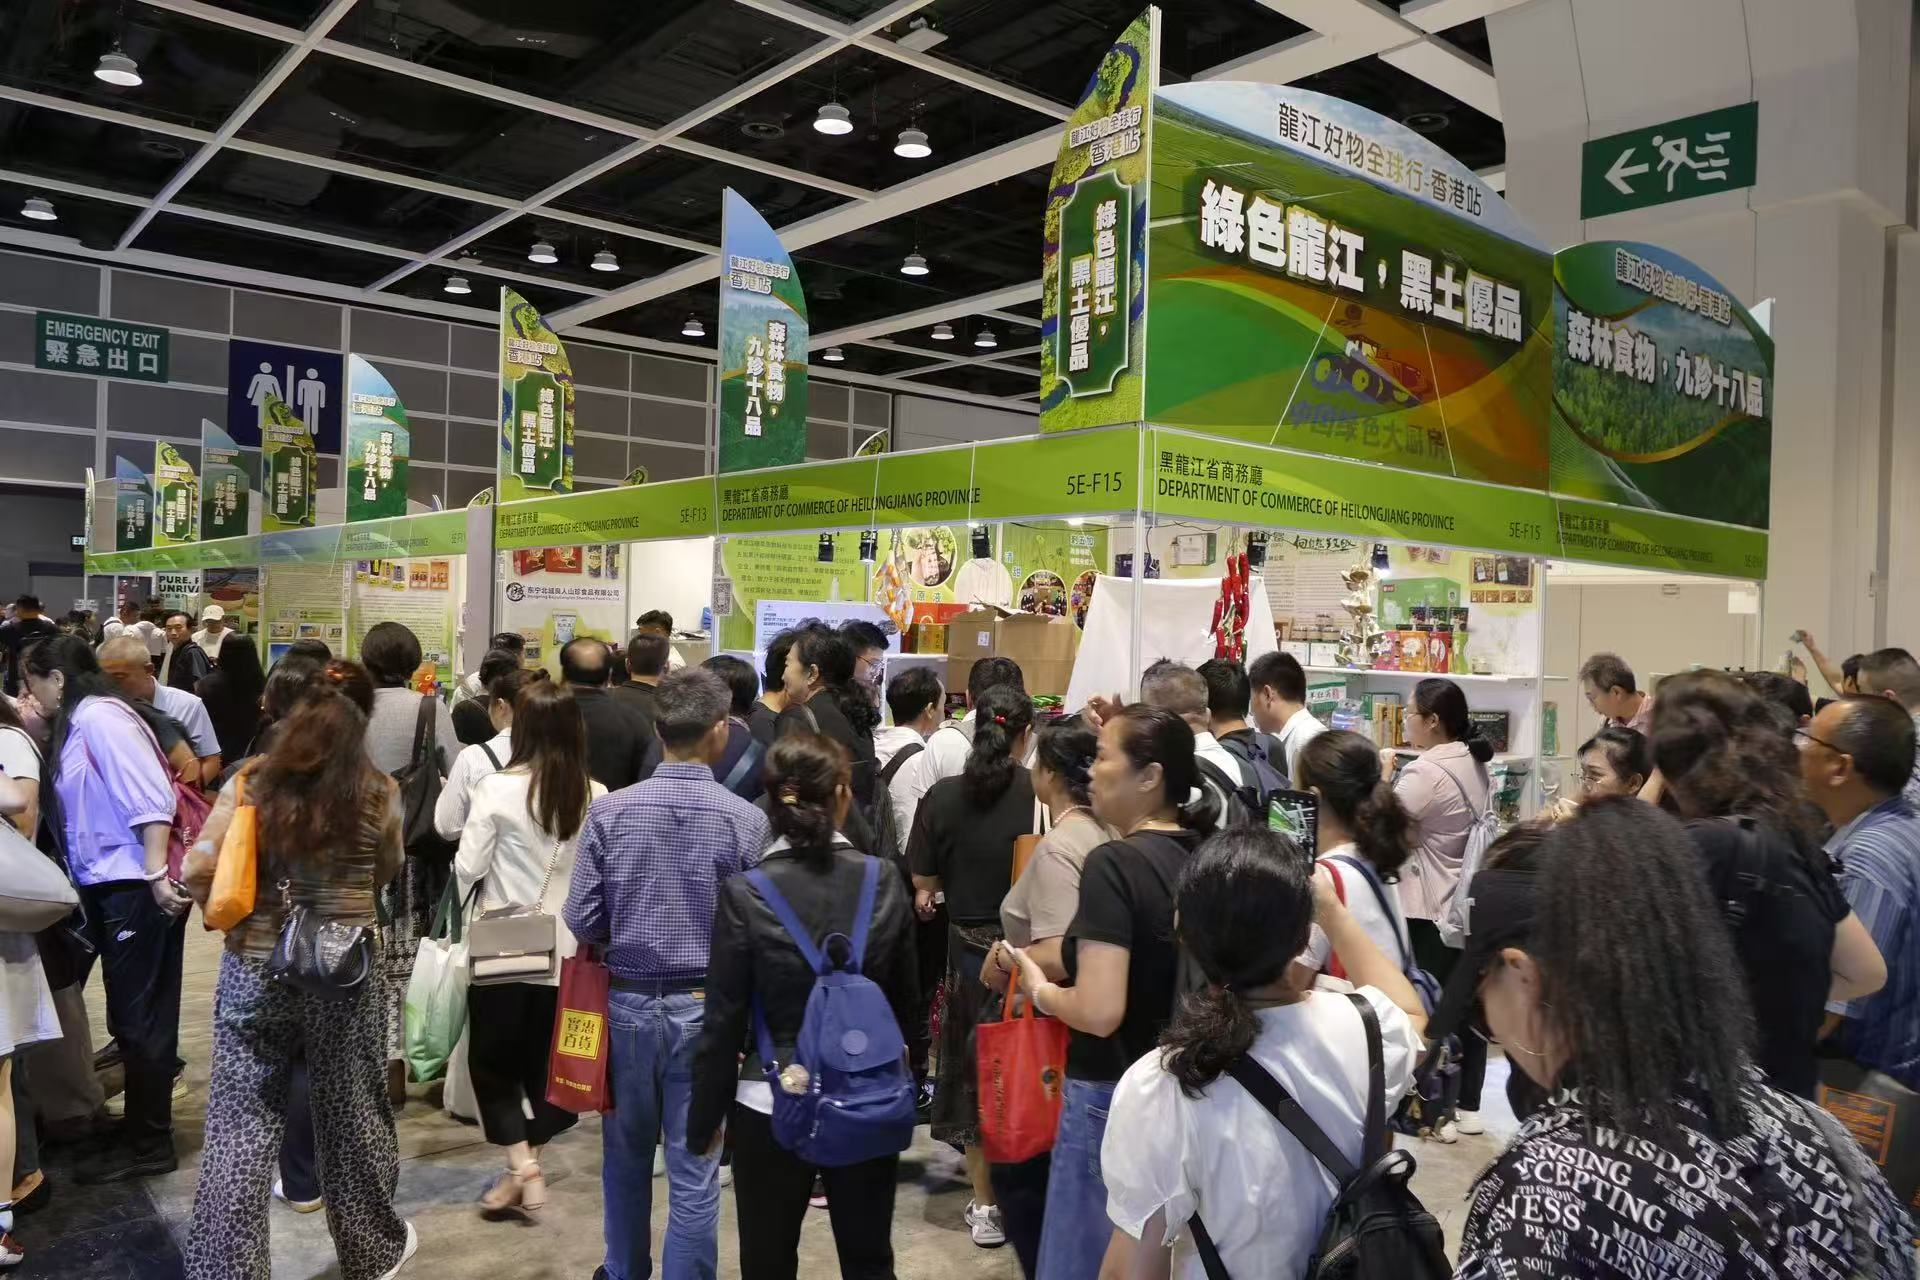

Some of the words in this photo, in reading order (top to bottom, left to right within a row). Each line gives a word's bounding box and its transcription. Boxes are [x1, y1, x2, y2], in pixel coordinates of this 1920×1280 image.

[1069, 106, 1142, 149] 龍江好物全球行
[1090, 131, 1141, 167] 香港站
[1279, 102, 1482, 217] 龍江好物全球行-香港站
[1200, 179, 1522, 342] 綠色龍江，黑土優品
[730, 271, 772, 294] 香港站
[1069, 259, 1091, 372] 黑土優品
[46, 320, 129, 345] EMERGENCY
[132, 332, 160, 350] EXIT
[45, 339, 159, 374] 緊急出口
[1567, 310, 1763, 418] 森林食物，九珍十八品
[745, 336, 764, 437] 九珍十八品
[1160, 451, 1263, 486] 黑龍江省商務廳
[722, 504, 773, 521] DEPARTMENT
[774, 504, 786, 518] OF
[786, 499, 835, 517] COMMERCE
[837, 498, 849, 513] OF
[851, 492, 923, 513] HEILONGJIANG
[926, 487, 980, 506] PROVINCE
[1066, 471, 1122, 496] 5E-F15
[723, 484, 789, 505] 黑龍江省商務廳
[1158, 478, 1240, 505] DEPARTMENT
[1242, 489, 1258, 506] OF
[1260, 491, 1322, 514] COMMERCE
[1324, 500, 1338, 516] OF
[1341, 502, 1409, 525] HEILONGJIANG
[1412, 511, 1455, 531] PROVINCE
[1509, 522, 1541, 540] 5E-F15
[72, 536, 87, 546] EXI
[499, 526, 529, 539] DEPARTMENT
[530, 526, 536, 537] OF
[537, 523, 564, 536] COMMERCE
[564, 522, 571, 534] OF
[611, 516, 639, 530] PROVINCE
[680, 507, 707, 523] 5E-F13
[159, 575, 192, 584] PURE.
